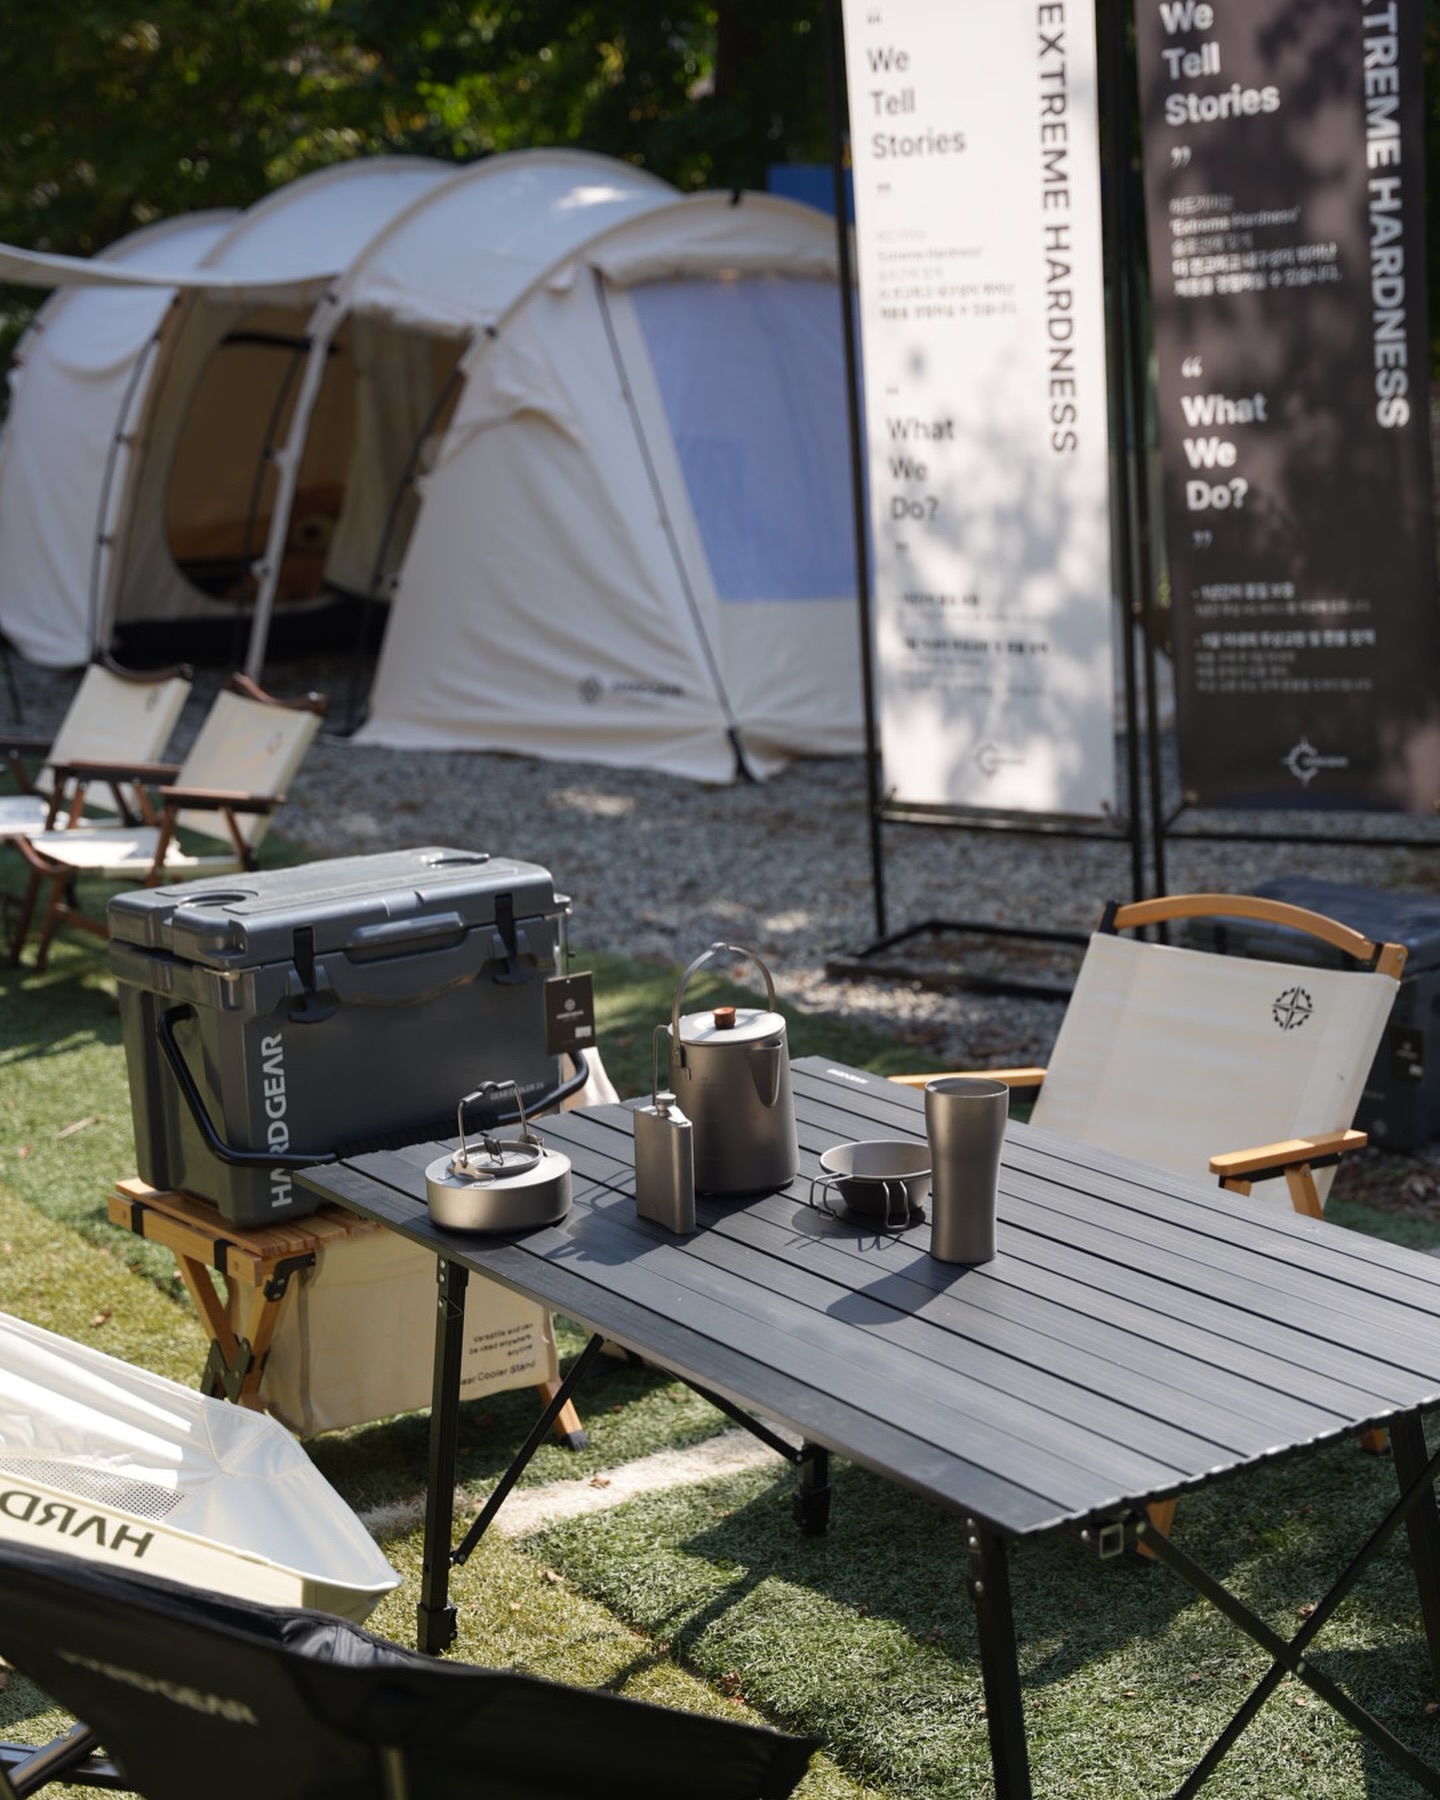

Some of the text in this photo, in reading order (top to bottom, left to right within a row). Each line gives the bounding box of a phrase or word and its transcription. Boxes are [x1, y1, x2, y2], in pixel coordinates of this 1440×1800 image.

[1160, 2, 1214, 35] We
[867, 46, 910, 72] We
[1162, 42, 1221, 79] Tell
[870, 89, 915, 116] Tell
[1165, 83, 1281, 125] Stories
[872, 129, 967, 159] Stories
[1038, 3, 1078, 453] EXTREME HARDNESS
[1361, 0, 1410, 429] TREME HARDNESS
[1181, 393, 1268, 427] What
[887, 416, 954, 441] What
[1184, 437, 1238, 468] We
[889, 456, 927, 481] We
[891, 495, 939, 521] Do?
[1186, 477, 1249, 511] Do?
[461, 1375, 476, 1386] ear
